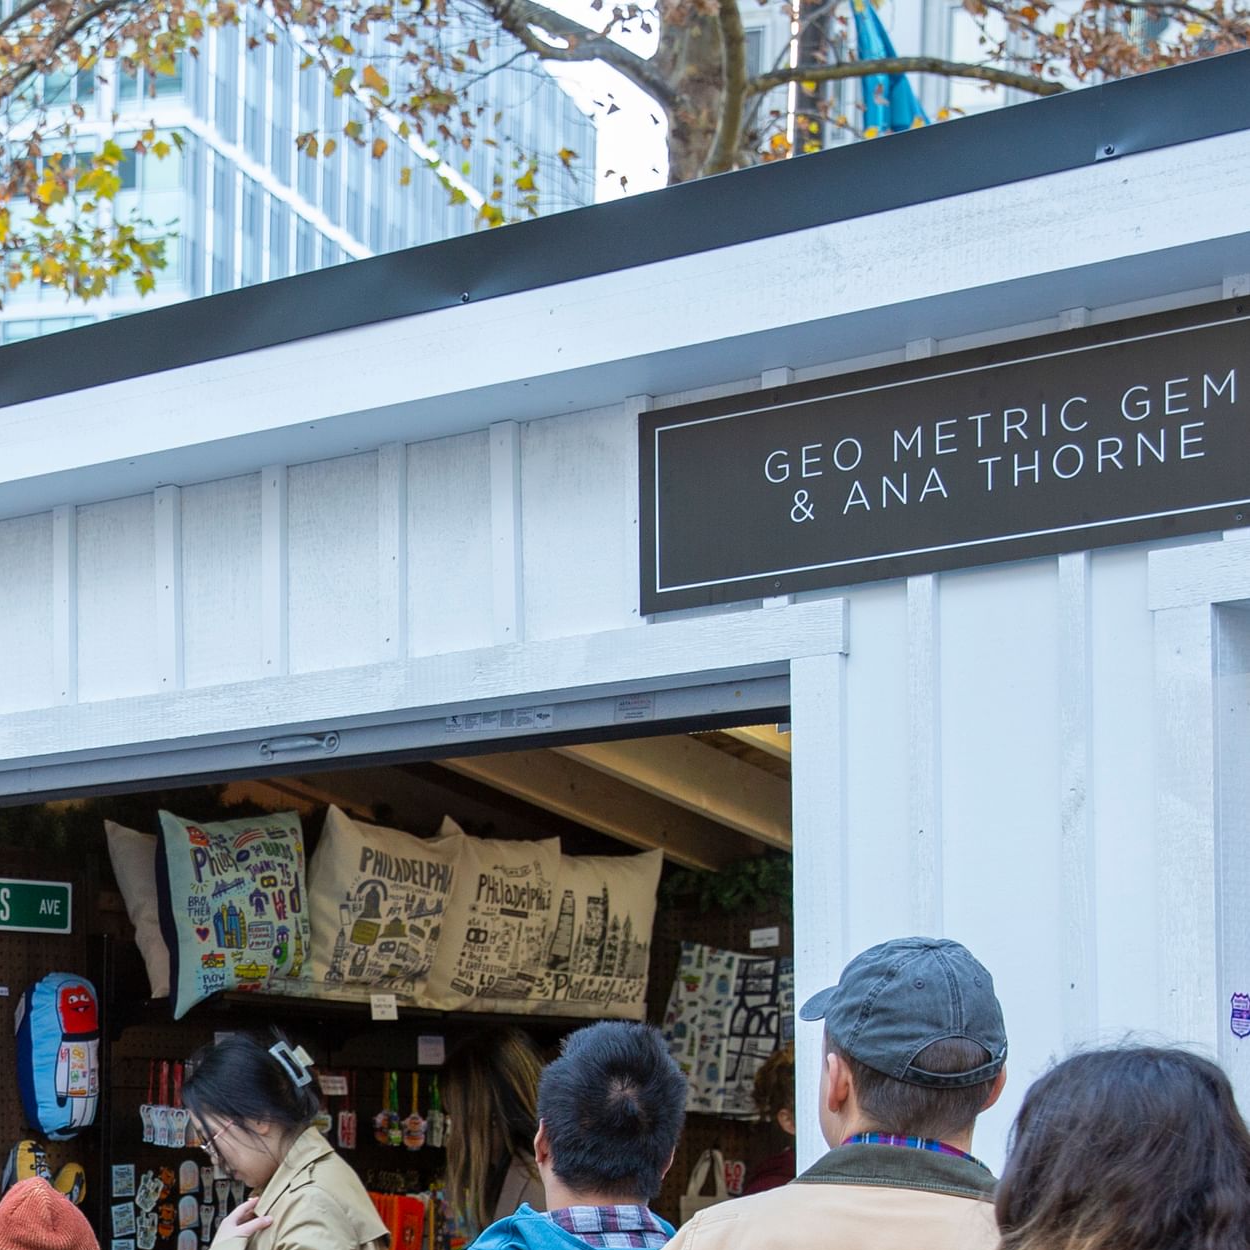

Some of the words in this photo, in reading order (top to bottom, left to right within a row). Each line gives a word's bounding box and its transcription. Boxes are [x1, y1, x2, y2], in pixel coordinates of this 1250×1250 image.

[765, 437, 863, 484] GEO
[893, 397, 1088, 462] METRIC
[1121, 369, 1237, 422] GEM
[790, 489, 815, 524] &
[843, 467, 948, 515] ANA
[978, 421, 1206, 491] THORNE
[39, 898, 61, 916] AVE
